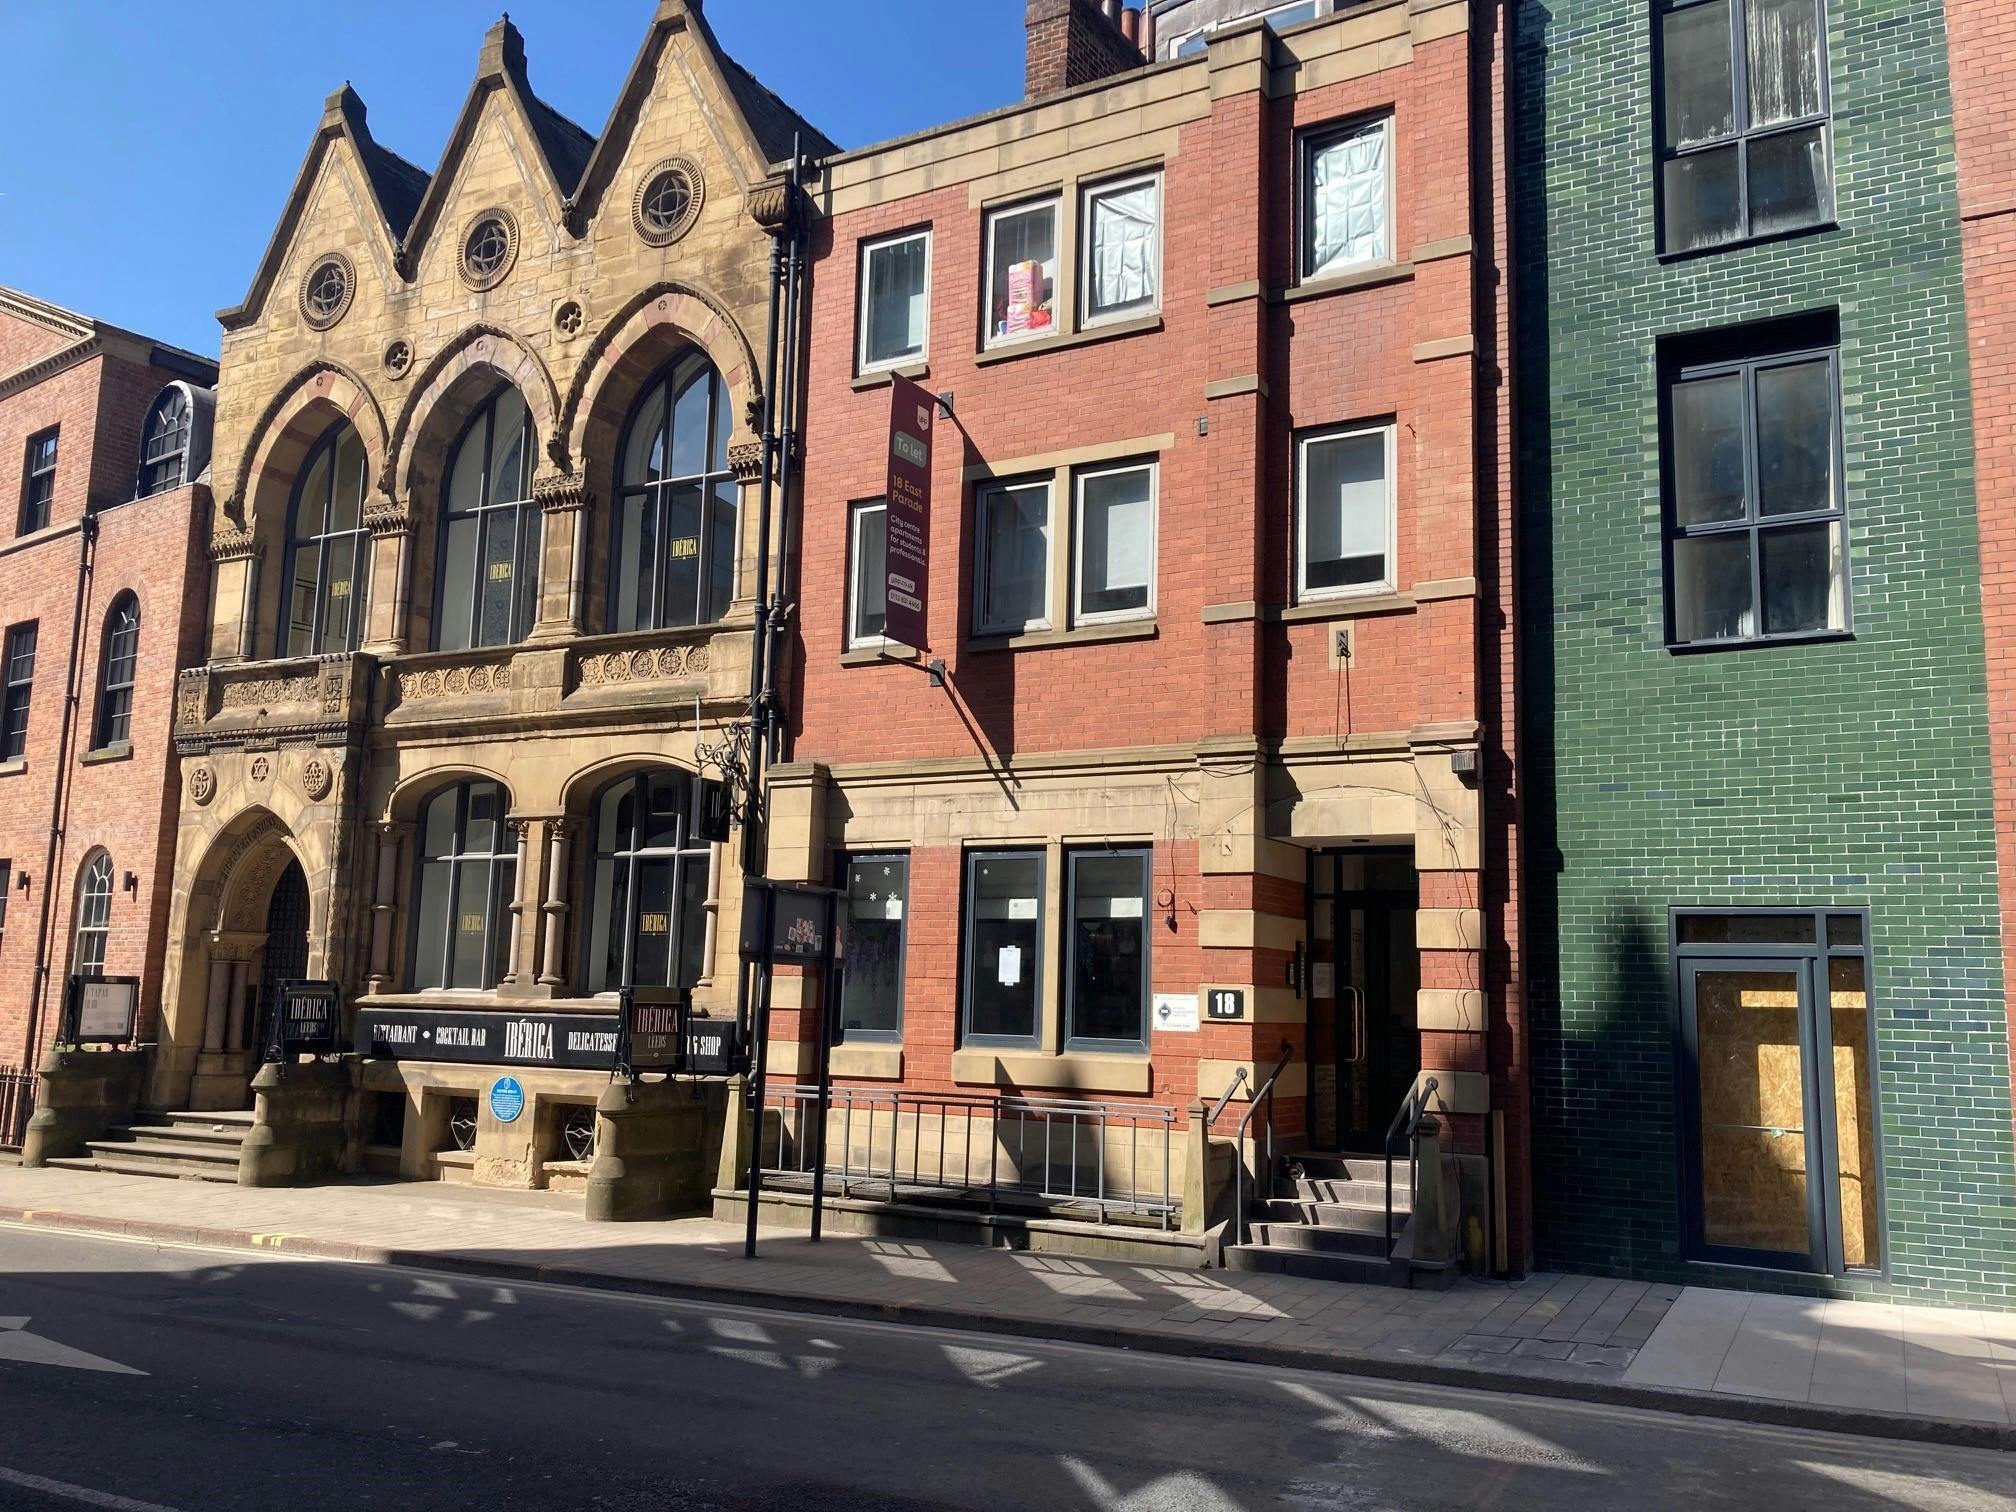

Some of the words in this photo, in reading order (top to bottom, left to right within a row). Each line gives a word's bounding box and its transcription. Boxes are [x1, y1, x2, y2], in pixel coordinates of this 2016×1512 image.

[897, 437, 909, 453] To
[910, 443, 922, 461] let
[893, 475, 903, 489] 18
[904, 480, 922, 498] East
[892, 490, 923, 513] Parade
[890, 526, 922, 544] apartments
[891, 515, 903, 528] City
[904, 521, 920, 534] centre
[890, 534, 899, 544] for
[900, 539, 921, 555] students
[291, 996, 327, 1019] IBÉRICA
[1215, 992, 1235, 1014] 18
[300, 1022, 317, 1033] LEEDS
[637, 1006, 678, 1033] IBÉRICA
[373, 1024, 417, 1044] RESTAURANT
[436, 1026, 470, 1046] COCKTAIL
[471, 1028, 486, 1046] BAR
[504, 1018, 554, 1059] IBÉRICA
[568, 1031, 618, 1052] DELICATESSE
[700, 1035, 722, 1056] SHOP
[648, 1035, 667, 1049] LEEDS
